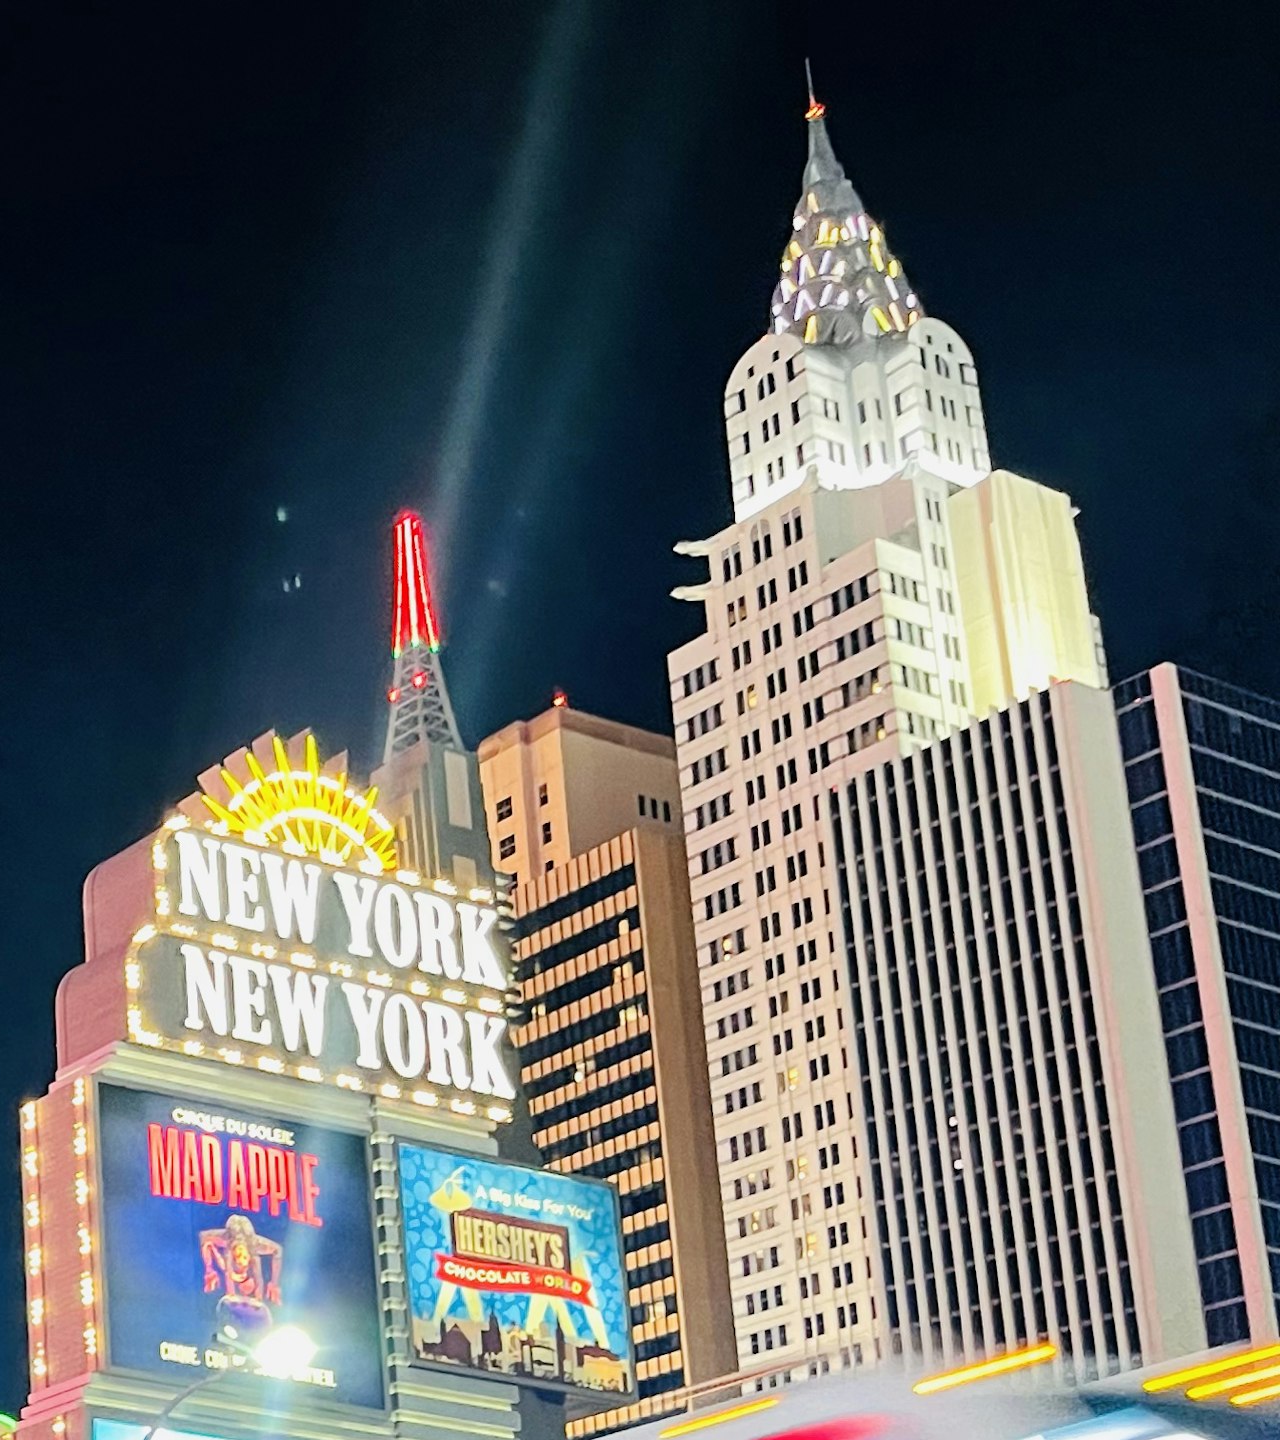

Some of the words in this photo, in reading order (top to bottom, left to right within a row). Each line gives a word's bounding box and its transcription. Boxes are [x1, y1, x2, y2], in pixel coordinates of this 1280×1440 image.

[174, 830, 323, 944] NEW
[333, 870, 509, 991] YORK
[180, 943, 330, 1057] NEW
[341, 982, 517, 1100] YORK
[171, 1107, 225, 1132] CIRQUE
[225, 1118, 247, 1136] DU
[148, 1122, 224, 1206] MAD
[227, 1138, 324, 1229] APPLE
[475, 1184, 487, 1200] A
[457, 1214, 566, 1271] HERSHEY'S
[443, 1261, 531, 1285] CHOCOLATE
